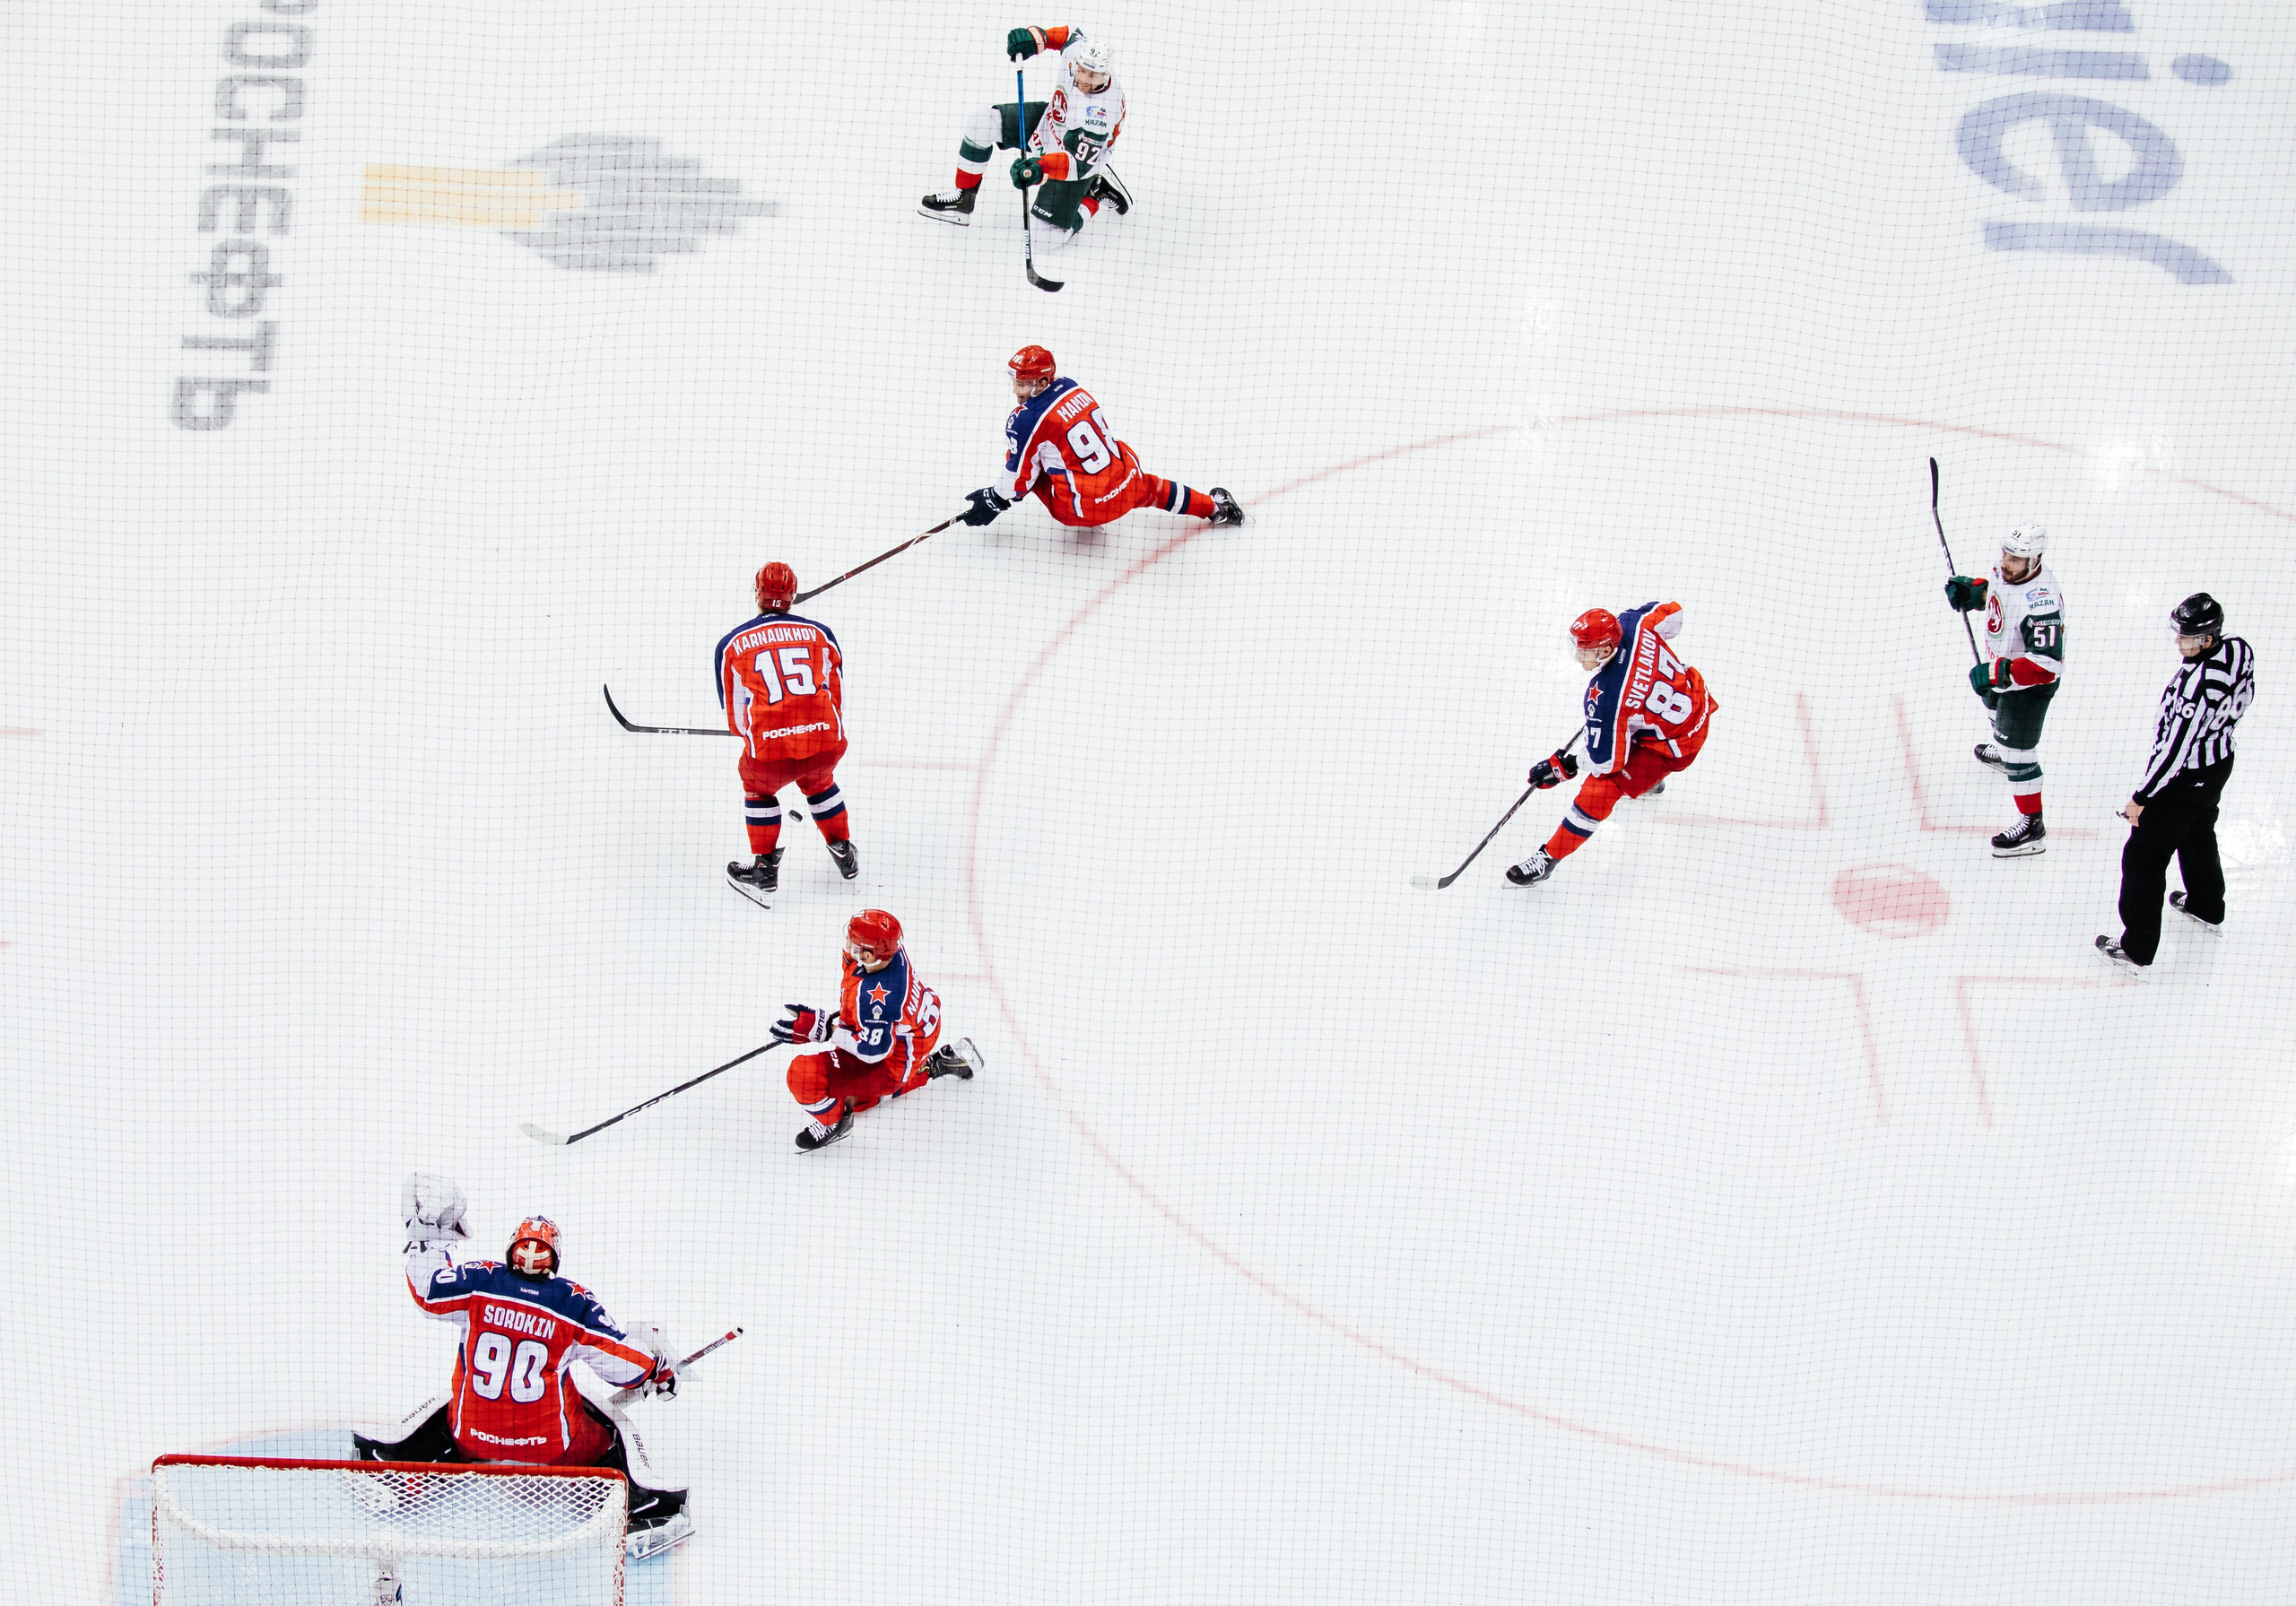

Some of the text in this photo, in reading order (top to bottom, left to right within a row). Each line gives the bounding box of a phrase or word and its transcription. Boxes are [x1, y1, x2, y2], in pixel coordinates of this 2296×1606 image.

[1085, 118, 1108, 127] KAZAN
[1075, 142, 1101, 166] 92
[1033, 204, 1053, 218] CCM
[1056, 391, 1094, 423] MAMIN
[772, 599, 782, 608] 15
[2029, 599, 2056, 611] KAZAN
[733, 628, 817, 656] KARNAUKHOV
[2033, 625, 2057, 648] 51
[753, 647, 818, 706] 15
[1624, 628, 1657, 710] SVETLAKOV
[1645, 644, 1693, 725] 87
[2175, 695, 2196, 720] 86
[2209, 677, 2248, 732] 86
[762, 722, 831, 740] РОСНЕФТЬ
[483, 1303, 556, 1341] SOROKIN
[472, 1331, 549, 1404] 90
[469, 1428, 548, 1446] РОСНЕФТЬ
